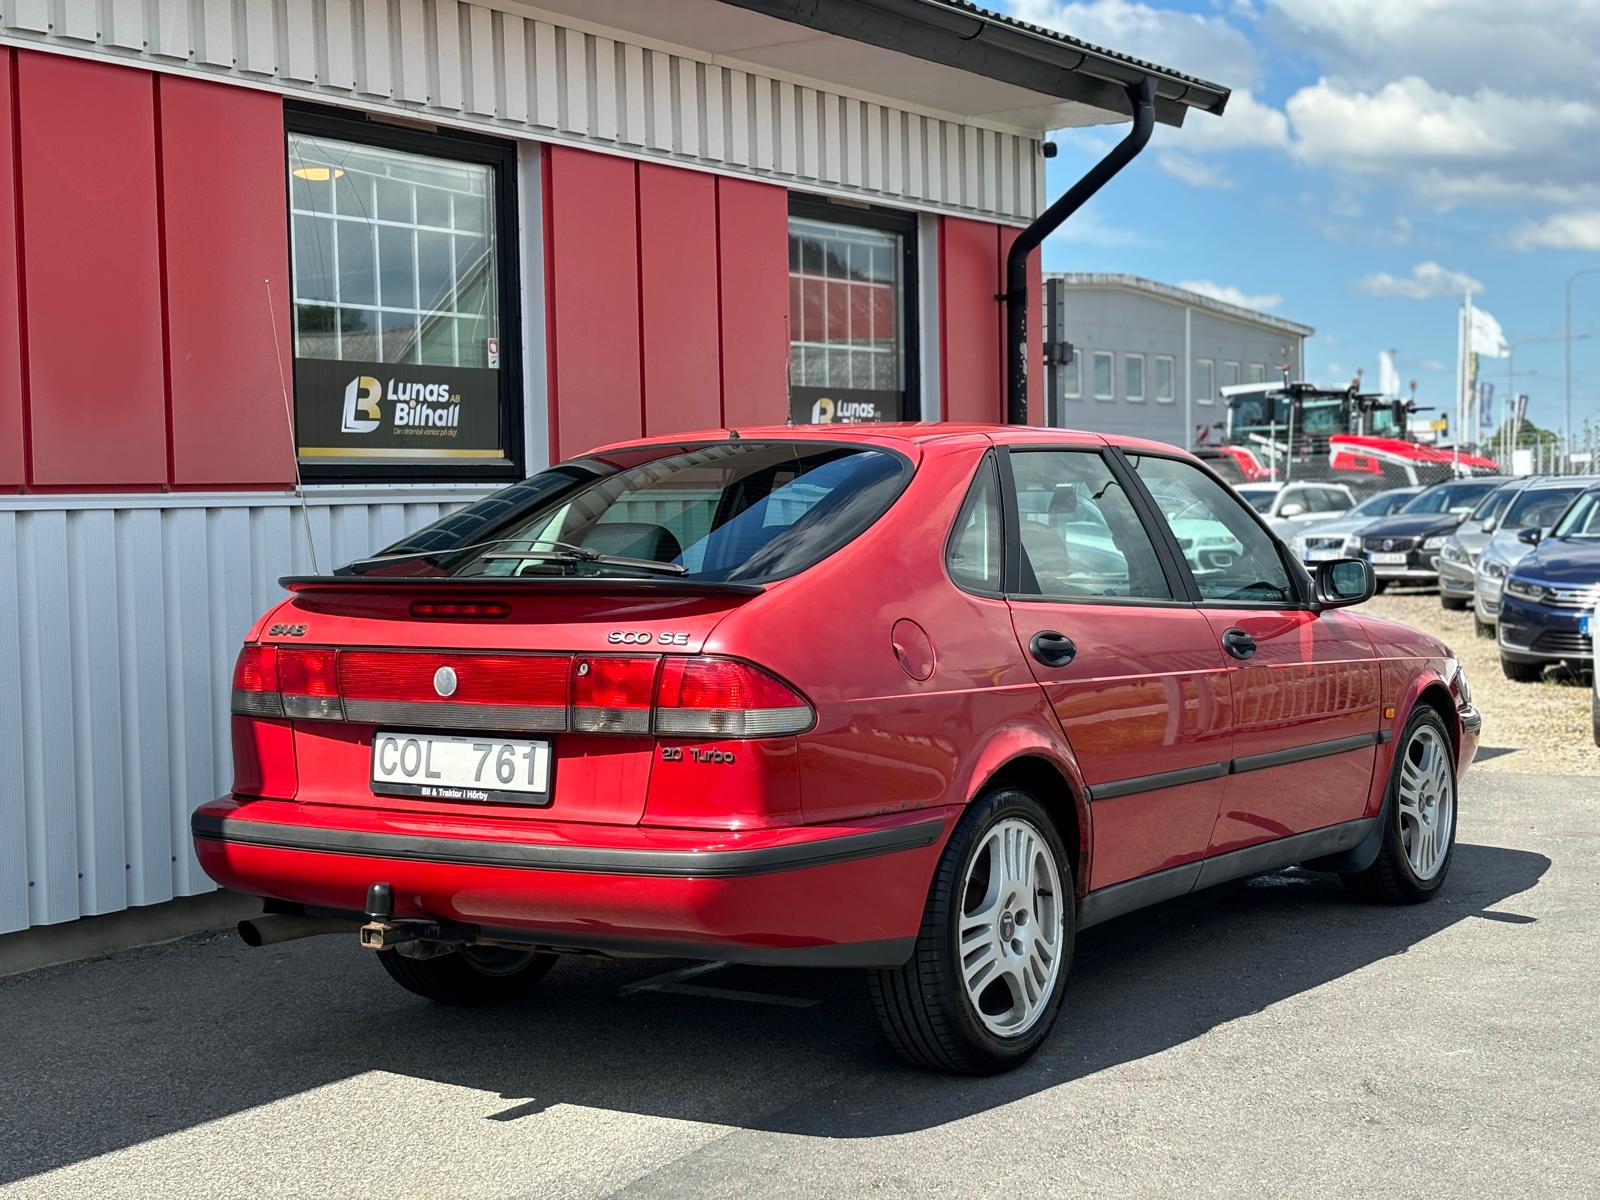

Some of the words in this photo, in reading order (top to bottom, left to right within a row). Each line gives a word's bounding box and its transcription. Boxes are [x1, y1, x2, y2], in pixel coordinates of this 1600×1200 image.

[387, 378, 450, 402] Lunas
[450, 394, 461, 403] AB
[394, 400, 460, 427] Bilhall
[836, 399, 875, 418] Lunas
[269, 624, 307, 637] SAAB
[608, 630, 652, 645] 900
[657, 632, 689, 645] SE
[379, 737, 442, 779] COL
[472, 743, 537, 785] 761
[690, 747, 735, 763] Turbo
[421, 787, 431, 795] Bil
[432, 788, 437, 796] &
[438, 788, 462, 798] Traktor
[467, 790, 488, 801] Hörby
